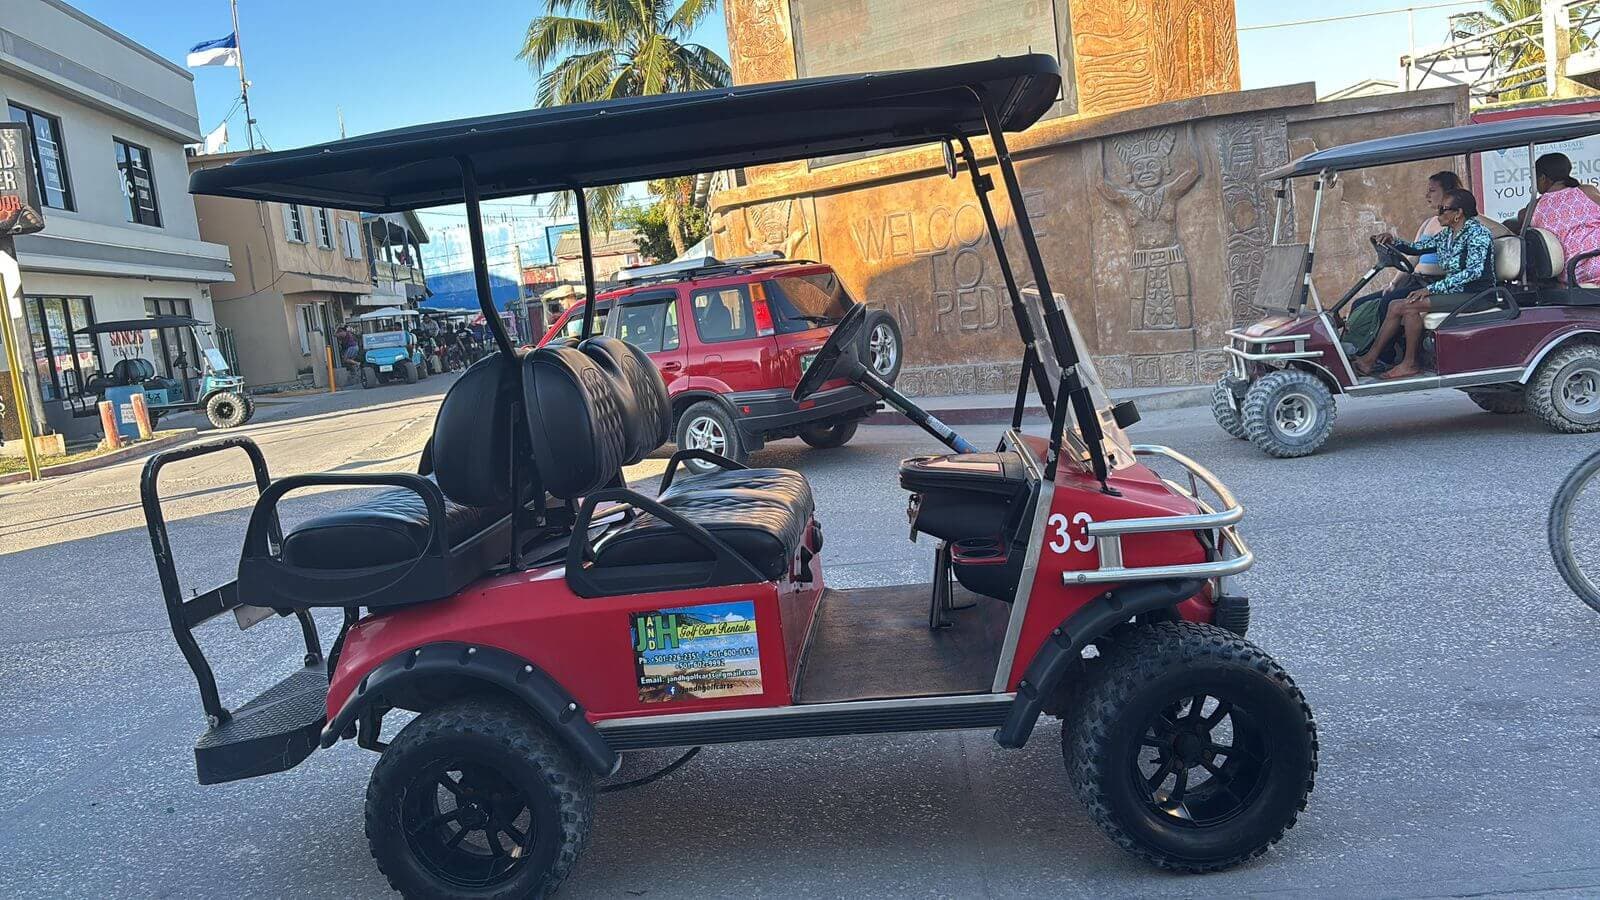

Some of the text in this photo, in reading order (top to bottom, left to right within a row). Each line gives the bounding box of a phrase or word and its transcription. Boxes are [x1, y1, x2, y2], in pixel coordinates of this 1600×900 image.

[1495, 186, 1525, 199] YOU
[1497, 210, 1515, 219] Your
[928, 247, 984, 291] TO
[1048, 512, 1096, 553] 33
[636, 614, 679, 652] J AND H
[679, 620, 751, 640] Golf Cart Rentals
